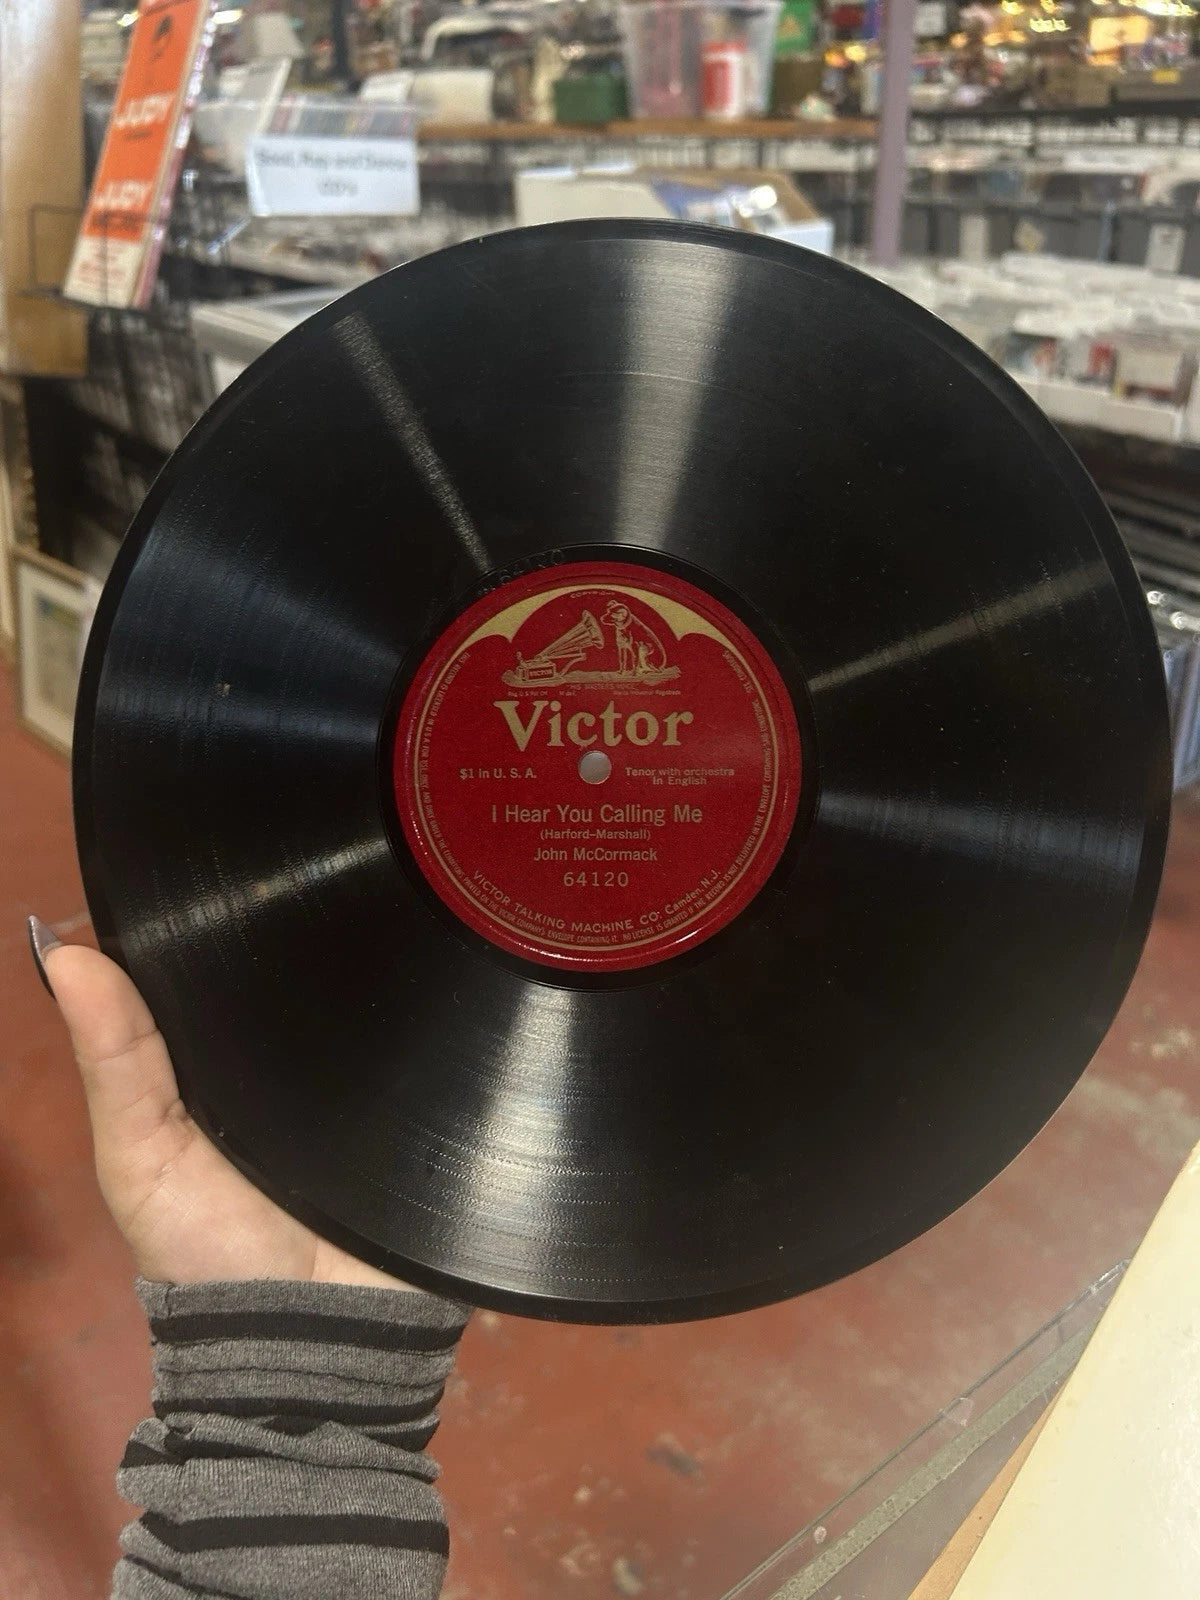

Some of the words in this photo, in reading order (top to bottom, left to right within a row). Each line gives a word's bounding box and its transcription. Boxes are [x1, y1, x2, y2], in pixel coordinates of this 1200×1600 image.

[493, 700, 694, 751] Victor
[459, 768, 475, 780] $1
[478, 768, 490, 779] in
[625, 766, 656, 776] Tenor
[659, 767, 681, 776] with
[683, 767, 735, 776] orchestra
[667, 776, 707, 787] English
[491, 804, 497, 823] I
[505, 804, 551, 823] Hear
[556, 804, 593, 823] You
[600, 804, 666, 826] Calling
[673, 804, 703, 823] Me
[533, 847, 568, 861] John
[573, 847, 658, 861] McCormack
[563, 871, 629, 887] 64120
[474, 870, 511, 906] VICTOR
[514, 902, 566, 929] TALKING
[571, 919, 634, 933] MACHINE
